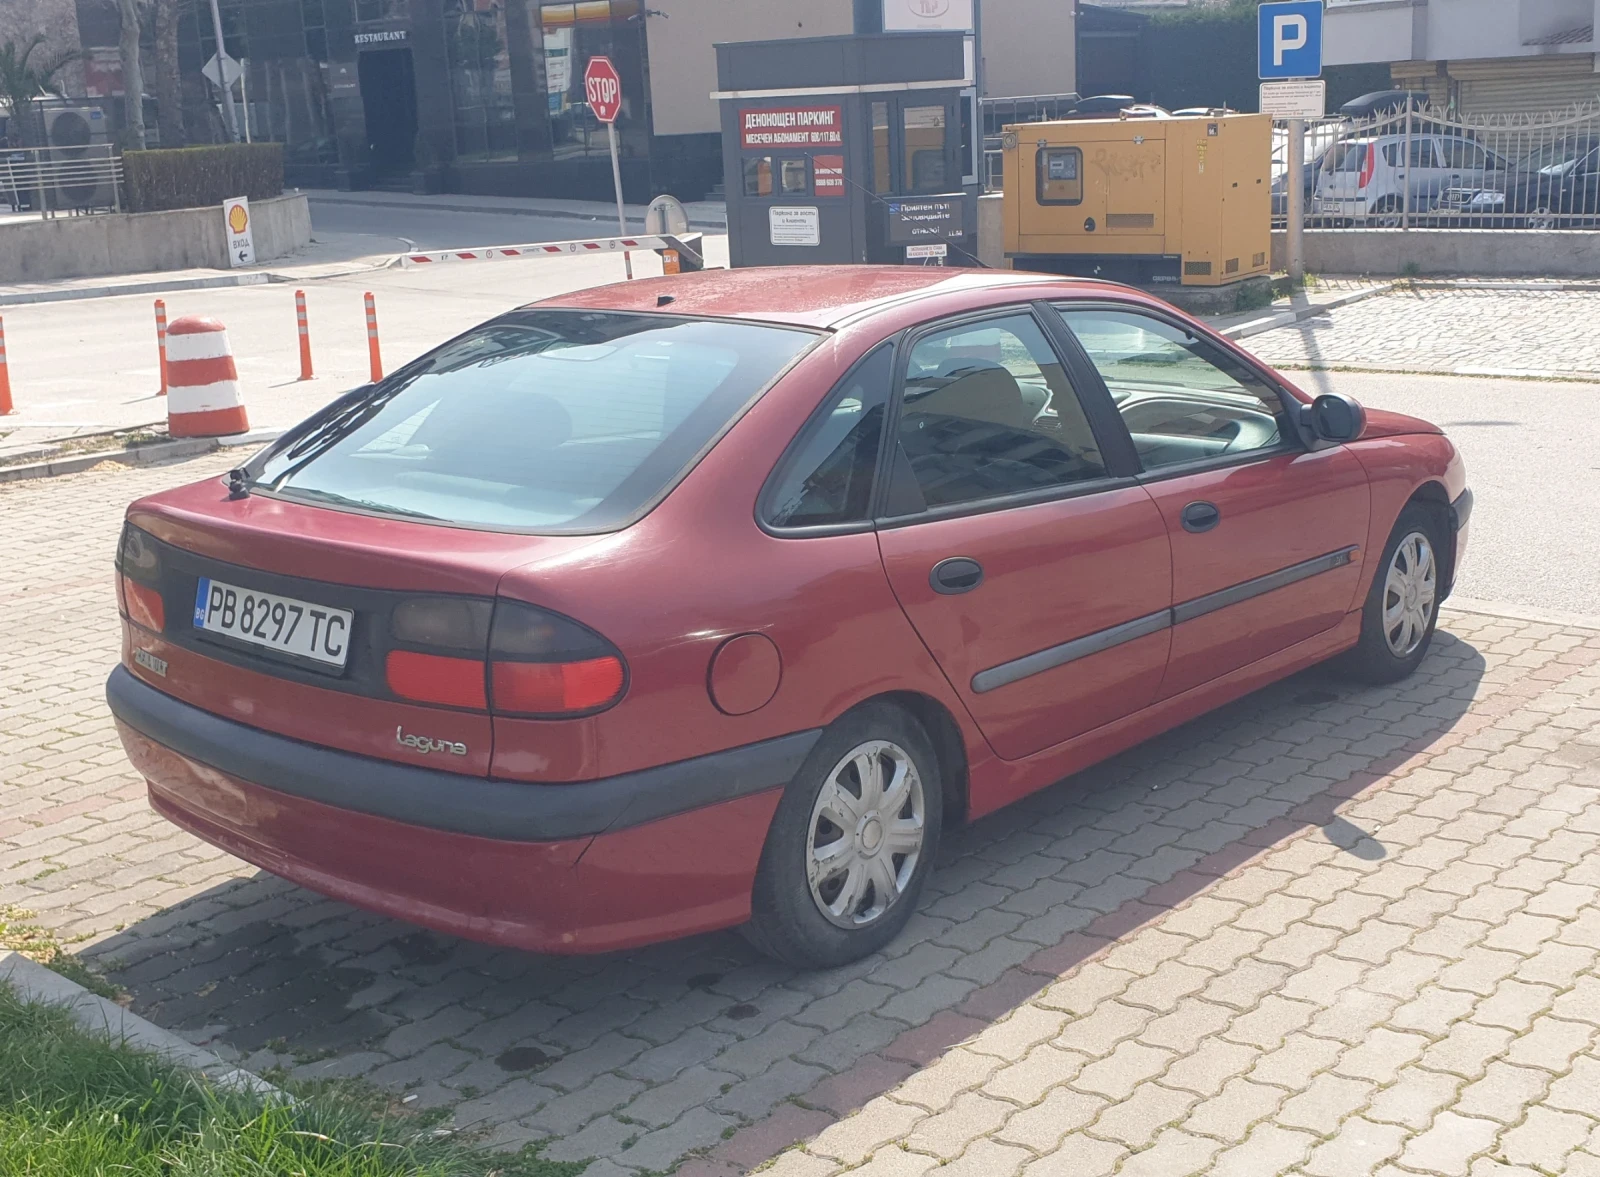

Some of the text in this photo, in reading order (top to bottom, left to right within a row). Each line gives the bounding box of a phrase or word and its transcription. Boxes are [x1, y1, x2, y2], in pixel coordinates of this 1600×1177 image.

[354, 31, 406, 44] RESTAURANT
[1273, 14, 1307, 66] P
[588, 77, 617, 104] STOP
[745, 111, 835, 129] ДЕНОНОЩЕН ПАРКИНГ
[745, 133, 773, 144] МЕСЕЧЕН
[773, 131, 809, 143] АБОНАМЕНТ
[232, 238, 250, 249] ВХОД
[195, 608, 205, 620] BG
[207, 585, 345, 657] PB 8297 TC
[396, 725, 467, 755] Laguna
